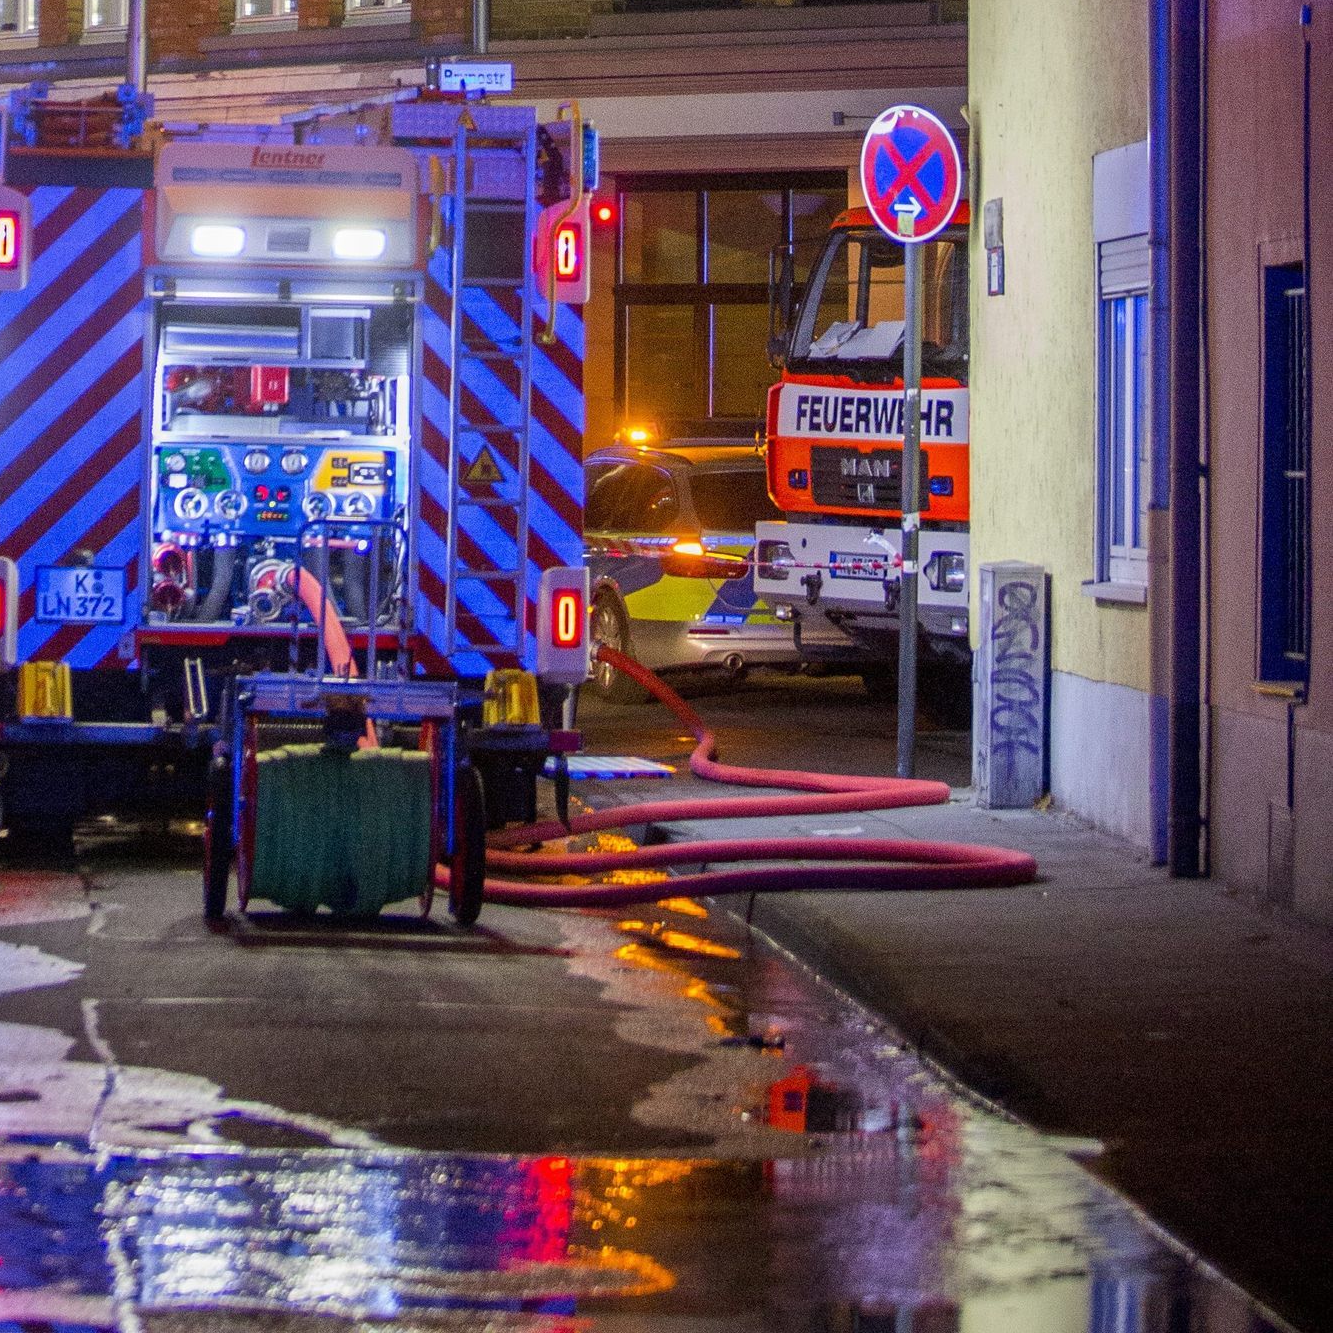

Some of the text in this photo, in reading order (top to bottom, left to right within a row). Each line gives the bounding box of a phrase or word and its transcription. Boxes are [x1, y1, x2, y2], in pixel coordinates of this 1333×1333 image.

[841, 458, 891, 478] MAN
[75, 573, 89, 593] K
[43, 592, 115, 617] LN 372
